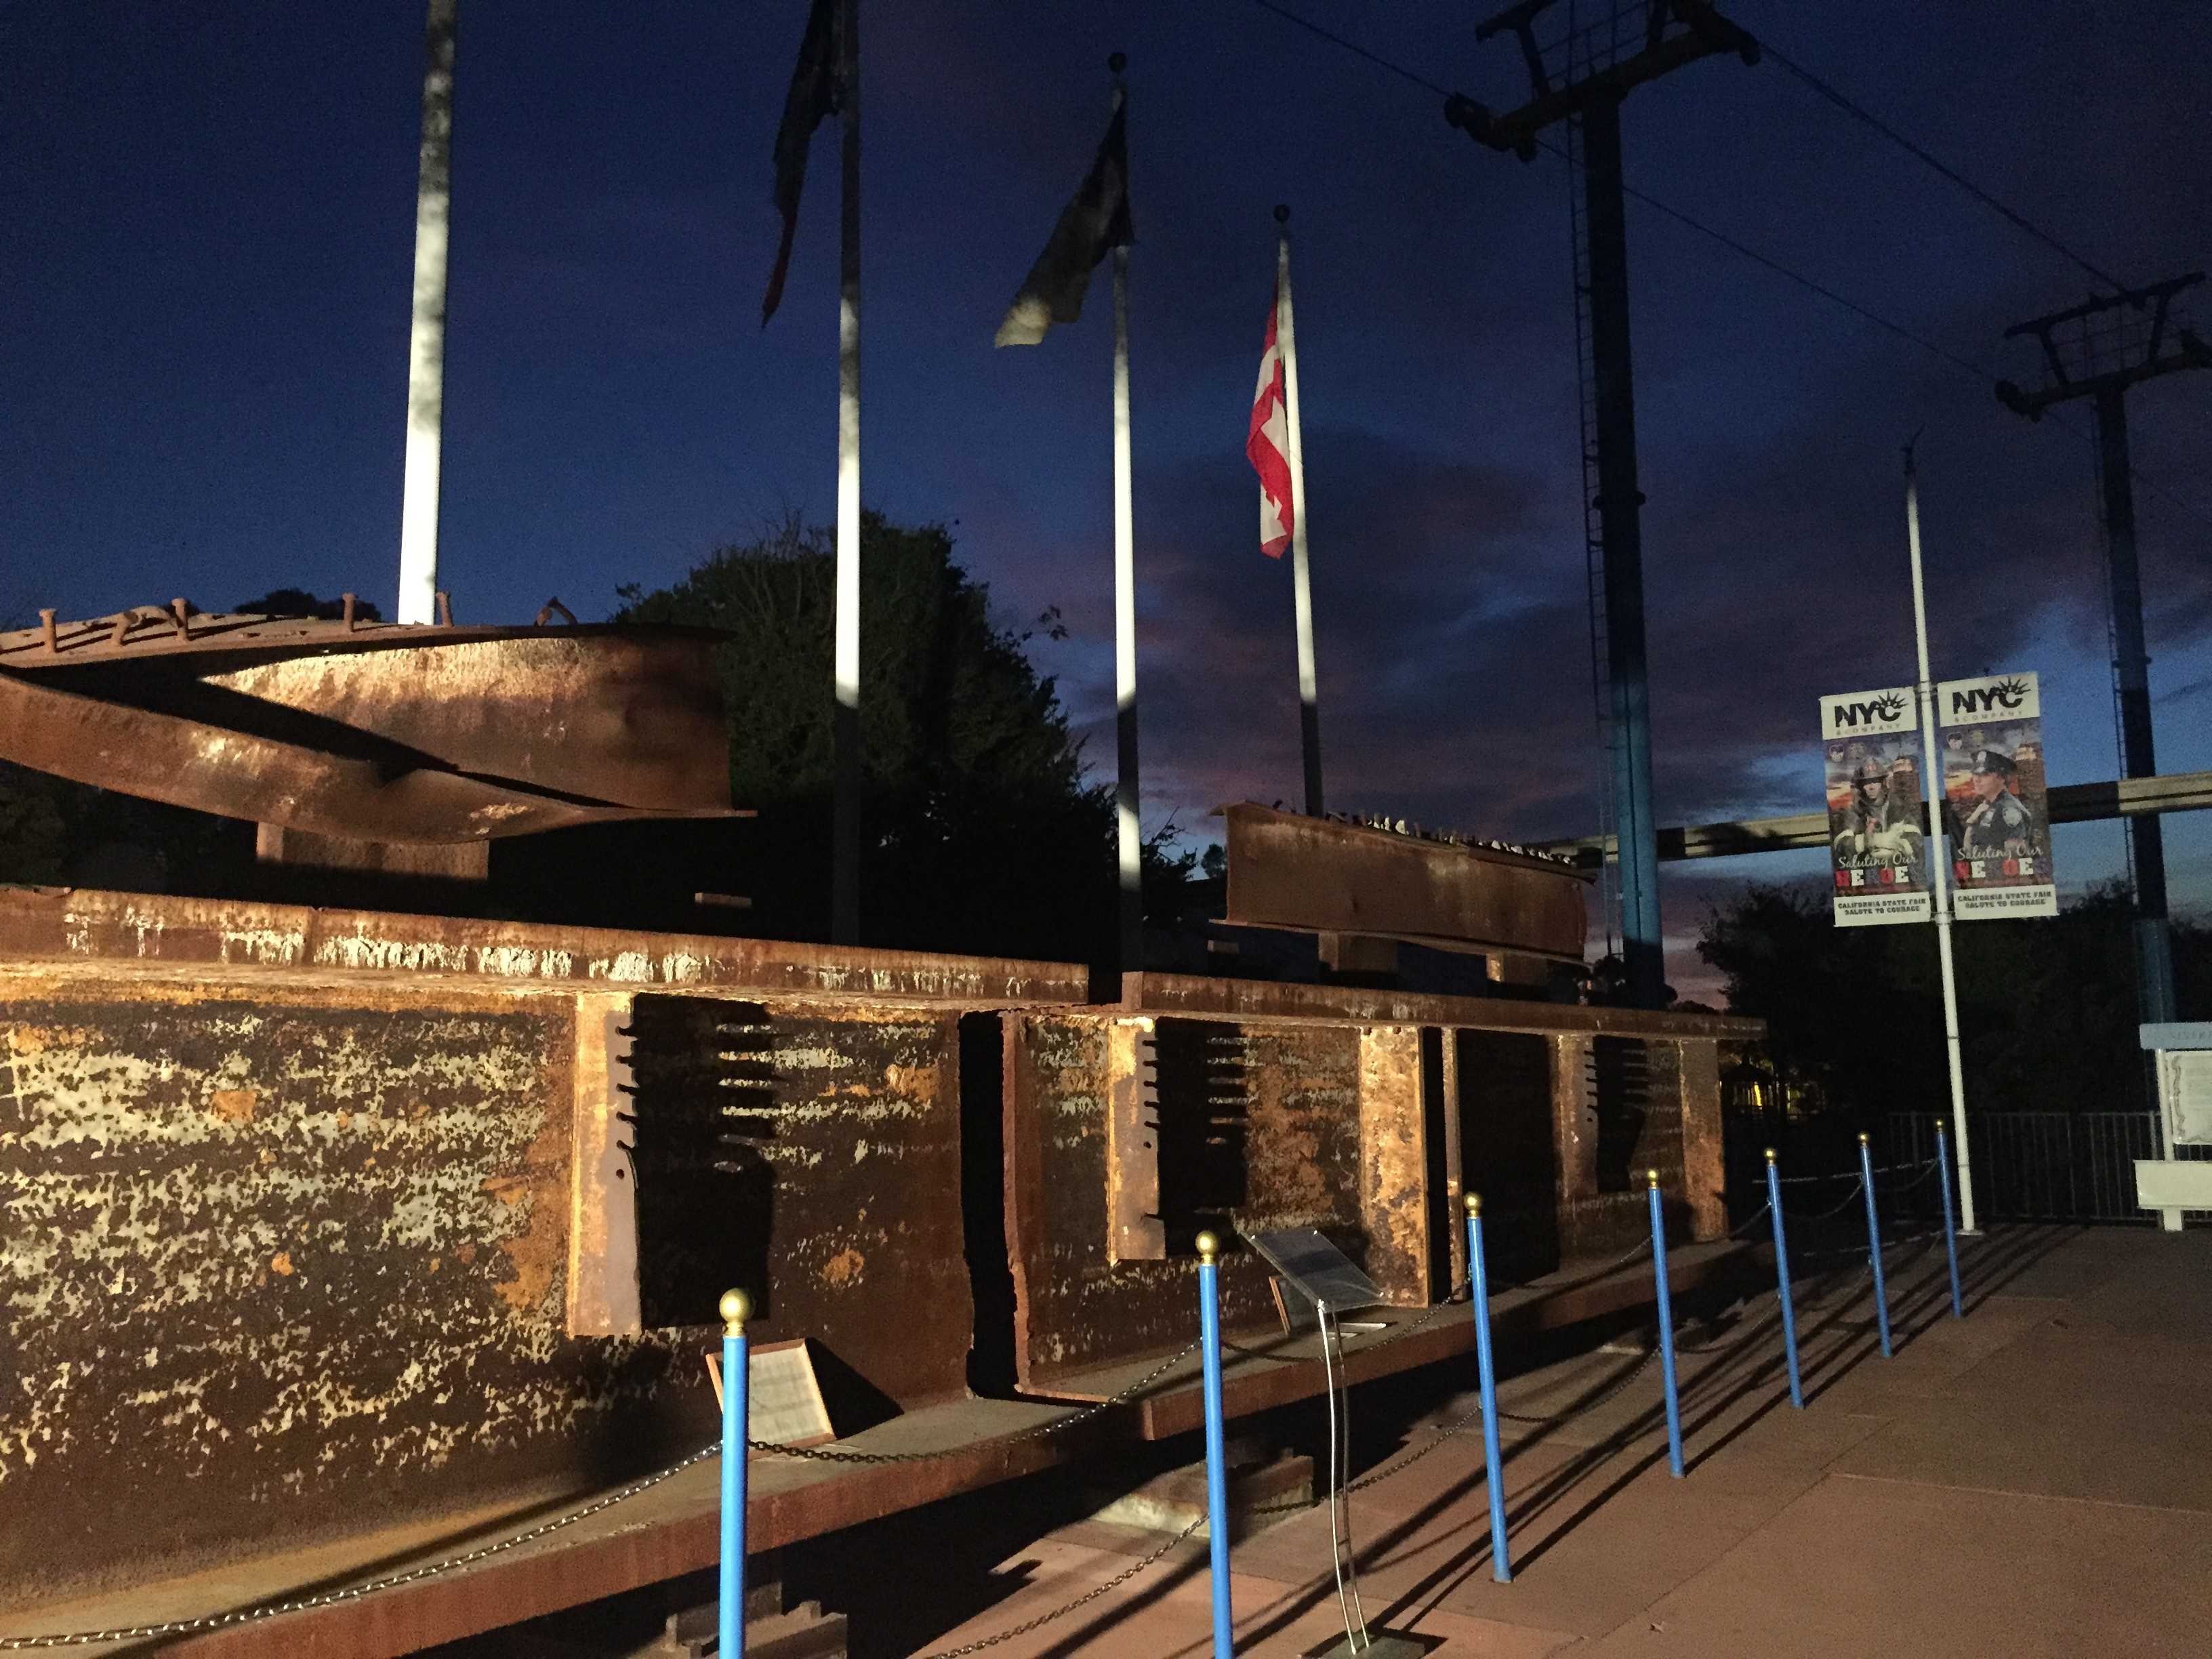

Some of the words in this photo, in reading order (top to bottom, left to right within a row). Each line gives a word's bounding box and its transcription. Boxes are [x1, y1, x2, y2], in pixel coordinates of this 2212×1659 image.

[1952, 680, 2026, 714] NYC
[1835, 695, 1904, 728] NYC
[1838, 853, 1888, 869] Saluting
[1893, 851, 1919, 865] Our
[2016, 840, 2044, 857] Our
